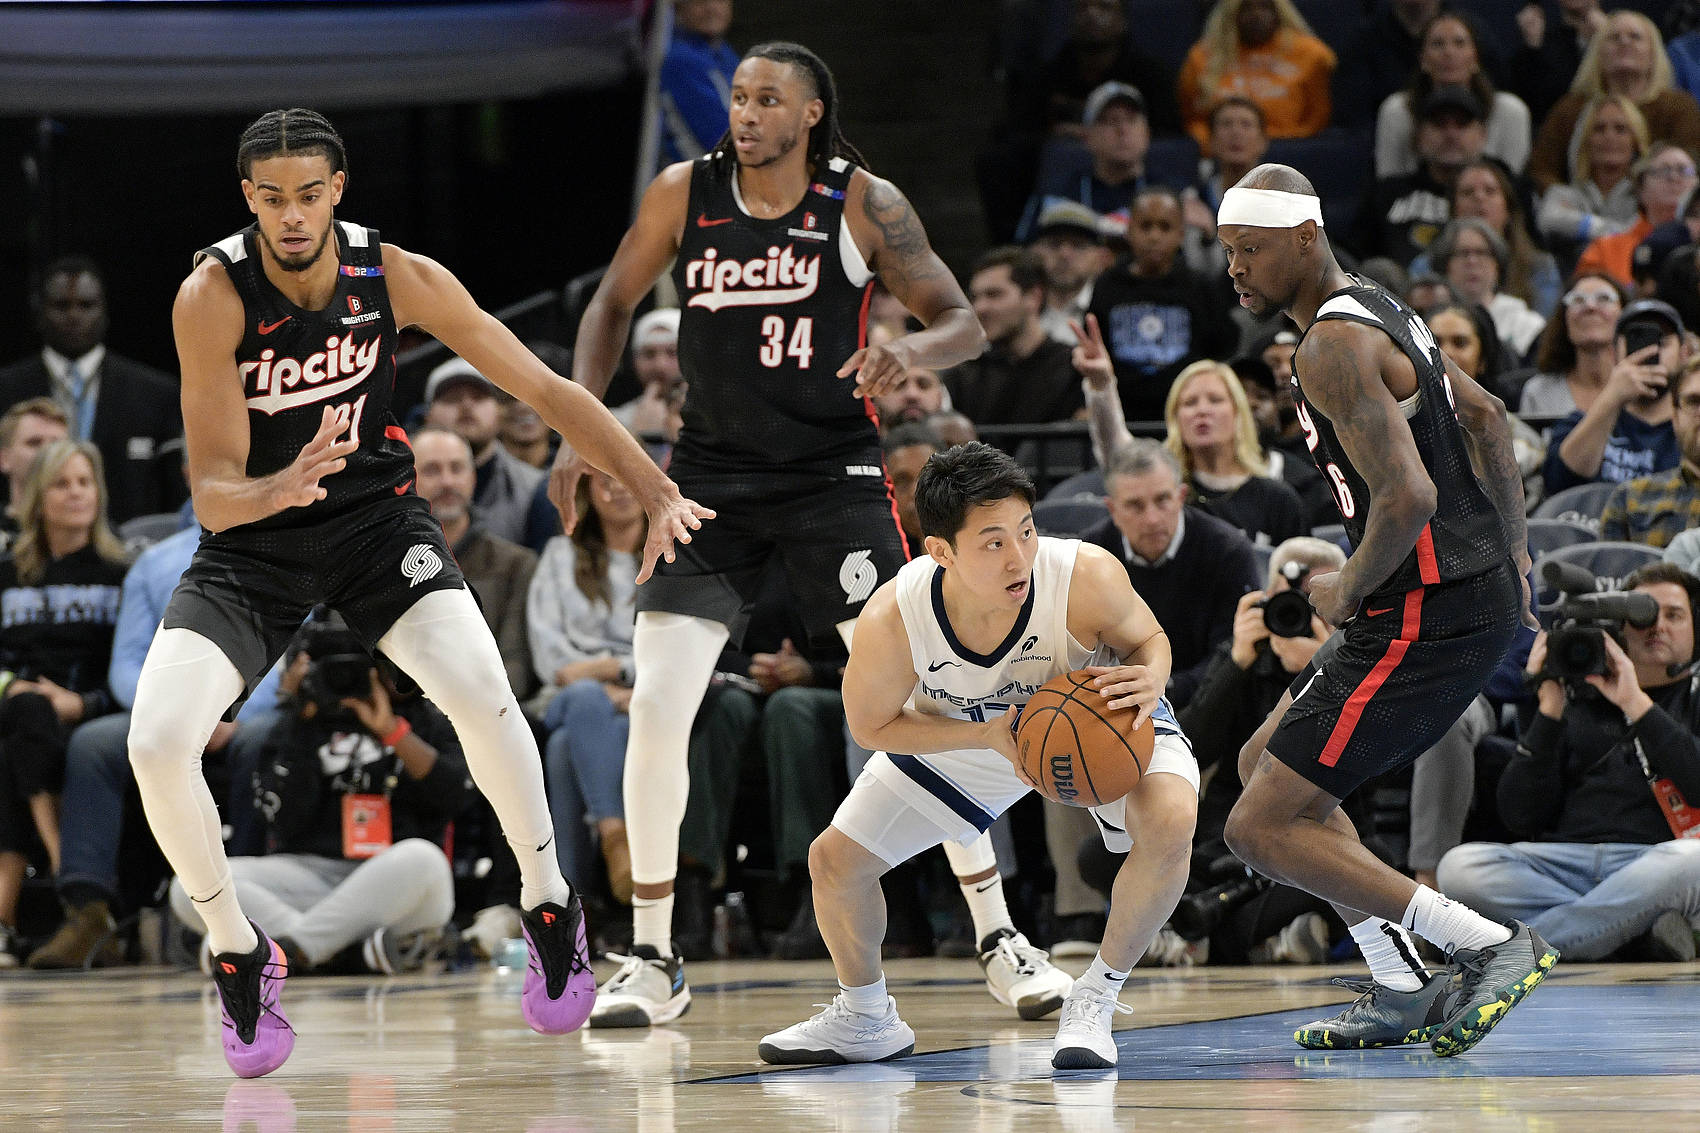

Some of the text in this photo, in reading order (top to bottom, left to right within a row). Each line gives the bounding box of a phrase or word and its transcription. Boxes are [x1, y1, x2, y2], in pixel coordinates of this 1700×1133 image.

[354, 267, 367, 276] 32
[686, 243, 821, 313] ripcity
[341, 310, 382, 325] BRIGHTSIDE
[759, 314, 814, 370] 34
[239, 330, 381, 416] ripcity
[1321, 462, 1355, 518] 6
[1010, 655, 1052, 664] Robinhood
[922, 680, 1042, 707] MEMPH
[1050, 754, 1079, 806] Wil
